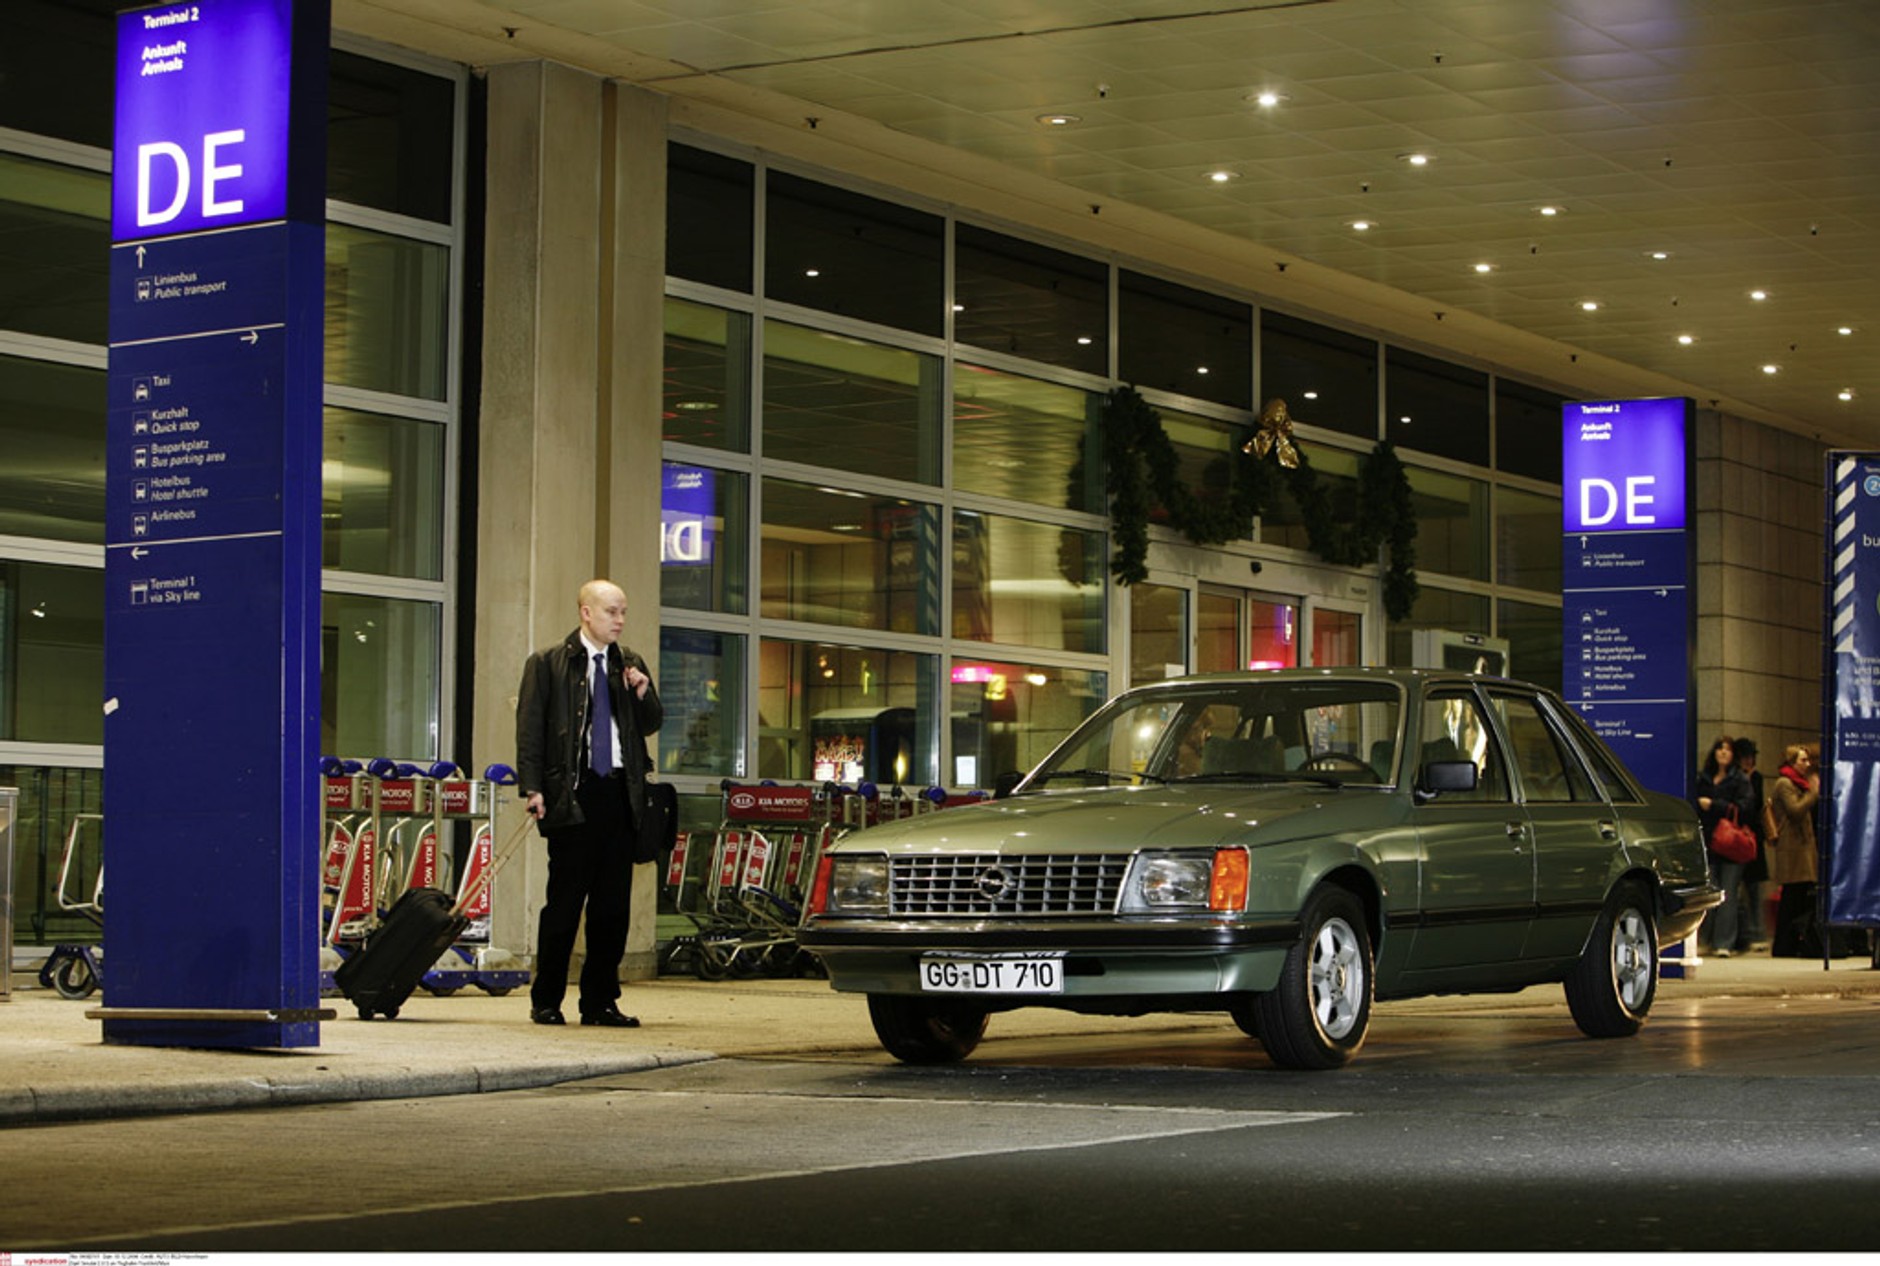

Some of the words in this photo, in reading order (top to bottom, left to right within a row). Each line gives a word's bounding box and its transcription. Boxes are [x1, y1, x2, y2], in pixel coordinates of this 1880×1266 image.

[142, 9, 189, 28] Terminal
[191, 6, 199, 21] 2
[141, 41, 187, 60] Ankunft
[141, 57, 183, 76] Arrivals
[137, 129, 245, 227] DE
[154, 272, 197, 286] Linienbus
[154, 286, 182, 299] Public
[184, 281, 227, 297] transport
[153, 376, 171, 387] Taxi
[152, 407, 188, 420] Kurzhalt
[152, 423, 177, 434] Quick
[180, 421, 200, 433] stop
[151, 440, 209, 454] Busparkplatz
[151, 456, 168, 468] Bus
[170, 454, 204, 467] parking
[206, 453, 226, 462] area
[151, 476, 190, 488] Hotelbus
[151, 489, 175, 501] Hotel
[177, 488, 208, 500] shuttle
[1580, 475, 1656, 526] DE
[151, 509, 196, 522] Airlinebus
[150, 577, 188, 589] Terminal
[190, 576, 195, 586] 1
[150, 592, 163, 602] via
[166, 590, 182, 603] Sky
[774, 798, 809, 807] MOTORS
[927, 962, 958, 987] GG
[973, 962, 1004, 988] DT
[1014, 962, 1054, 988] 710
